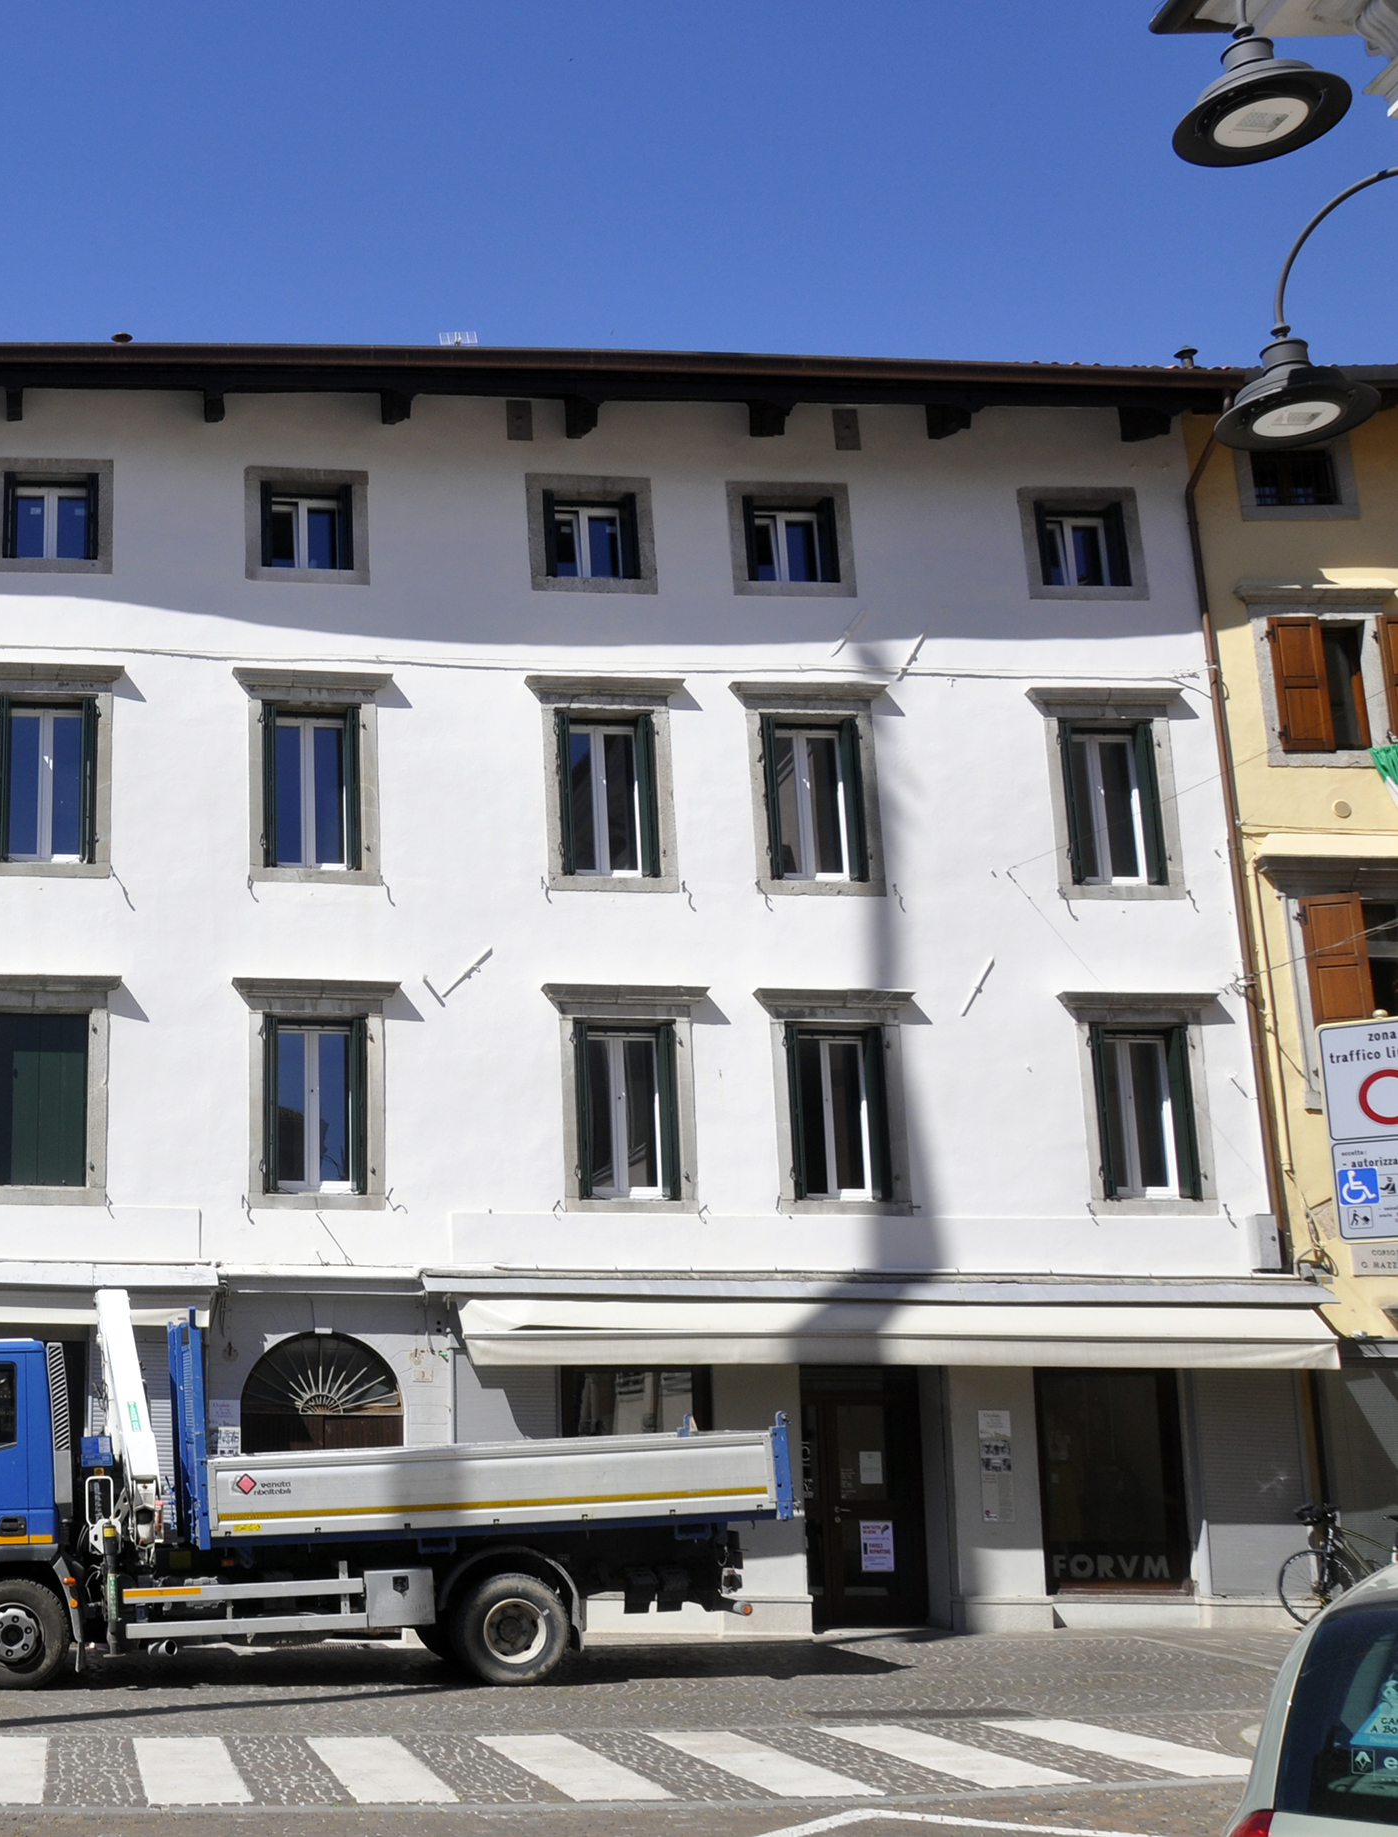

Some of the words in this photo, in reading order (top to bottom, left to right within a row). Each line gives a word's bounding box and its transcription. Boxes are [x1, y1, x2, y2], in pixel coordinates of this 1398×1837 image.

[1368, 1031, 1397, 1041] zona
[1329, 1049, 1381, 1064] traffico
[1386, 1046, 1398, 1058] li
[1371, 1725, 1378, 1733] A
